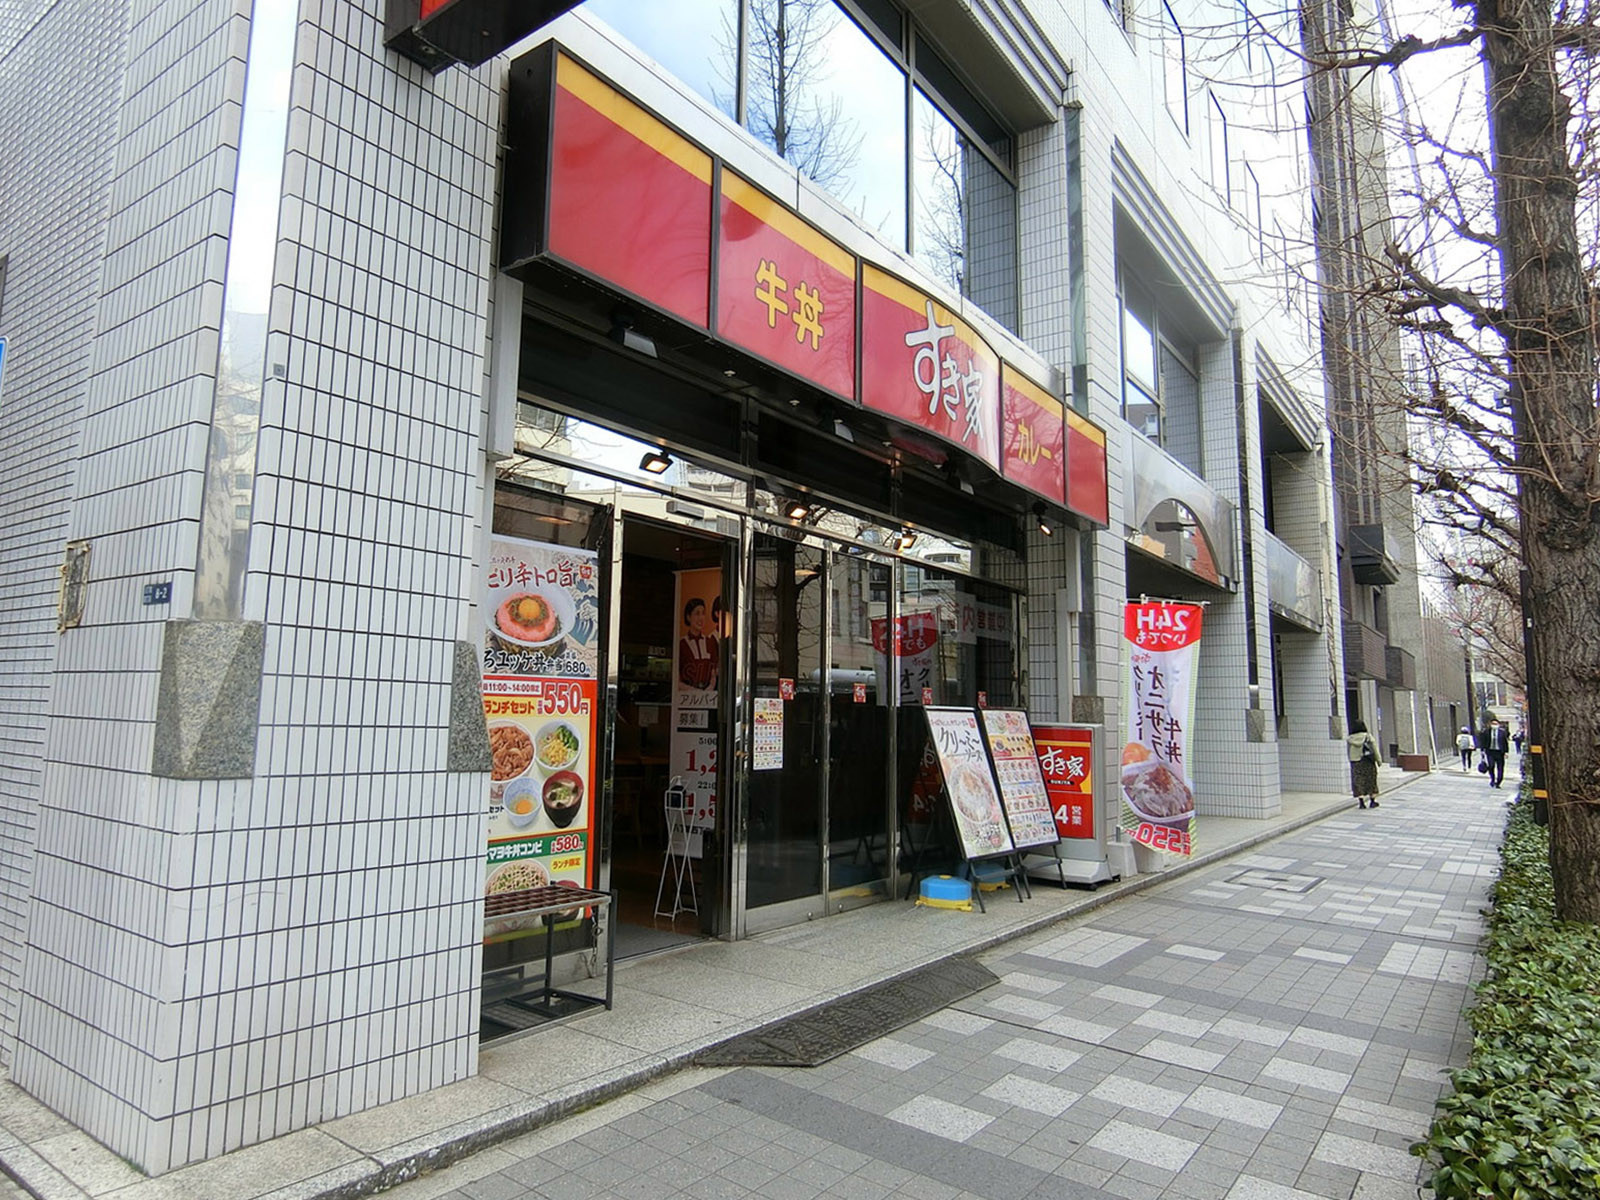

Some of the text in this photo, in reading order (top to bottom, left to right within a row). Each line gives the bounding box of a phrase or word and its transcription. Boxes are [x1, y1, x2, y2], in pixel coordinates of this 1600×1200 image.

[755, 259, 825, 351] 牛丼
[904, 300, 984, 442] すき家
[1017, 418, 1052, 466] カレー
[544, 684, 588, 715] 550円
[1039, 746, 1085, 780] すき家
[1052, 804, 1069, 824] 4
